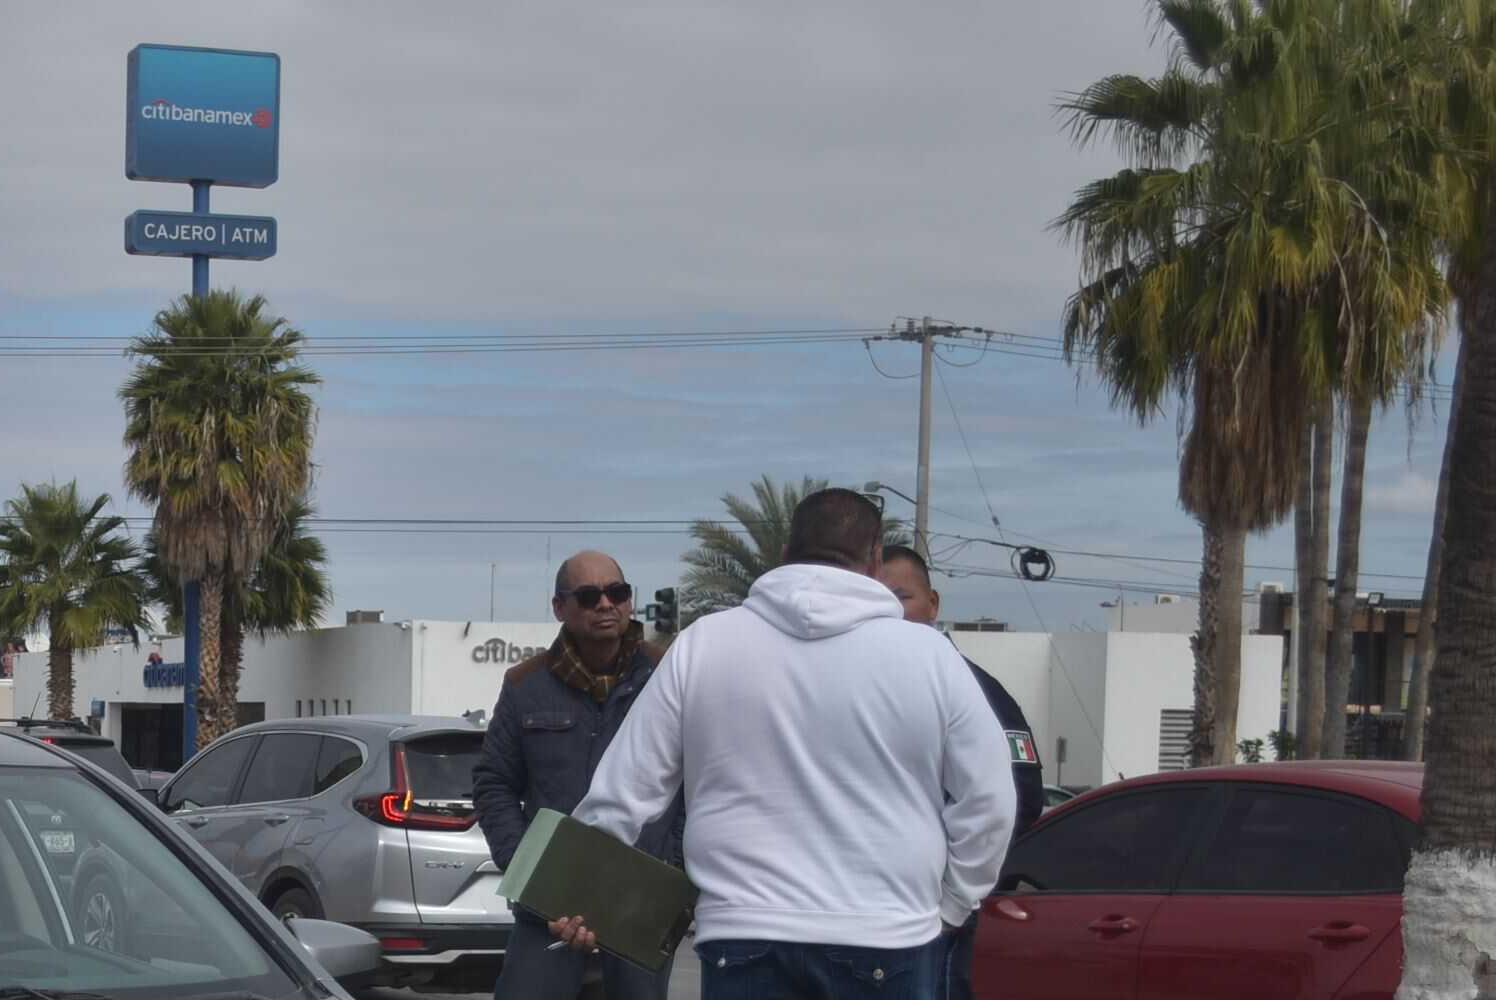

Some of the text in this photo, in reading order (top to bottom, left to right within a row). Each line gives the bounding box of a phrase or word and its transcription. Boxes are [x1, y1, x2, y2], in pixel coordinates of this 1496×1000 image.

[142, 102, 253, 126] citibanamex
[144, 223, 268, 244] CAJERO ATM
